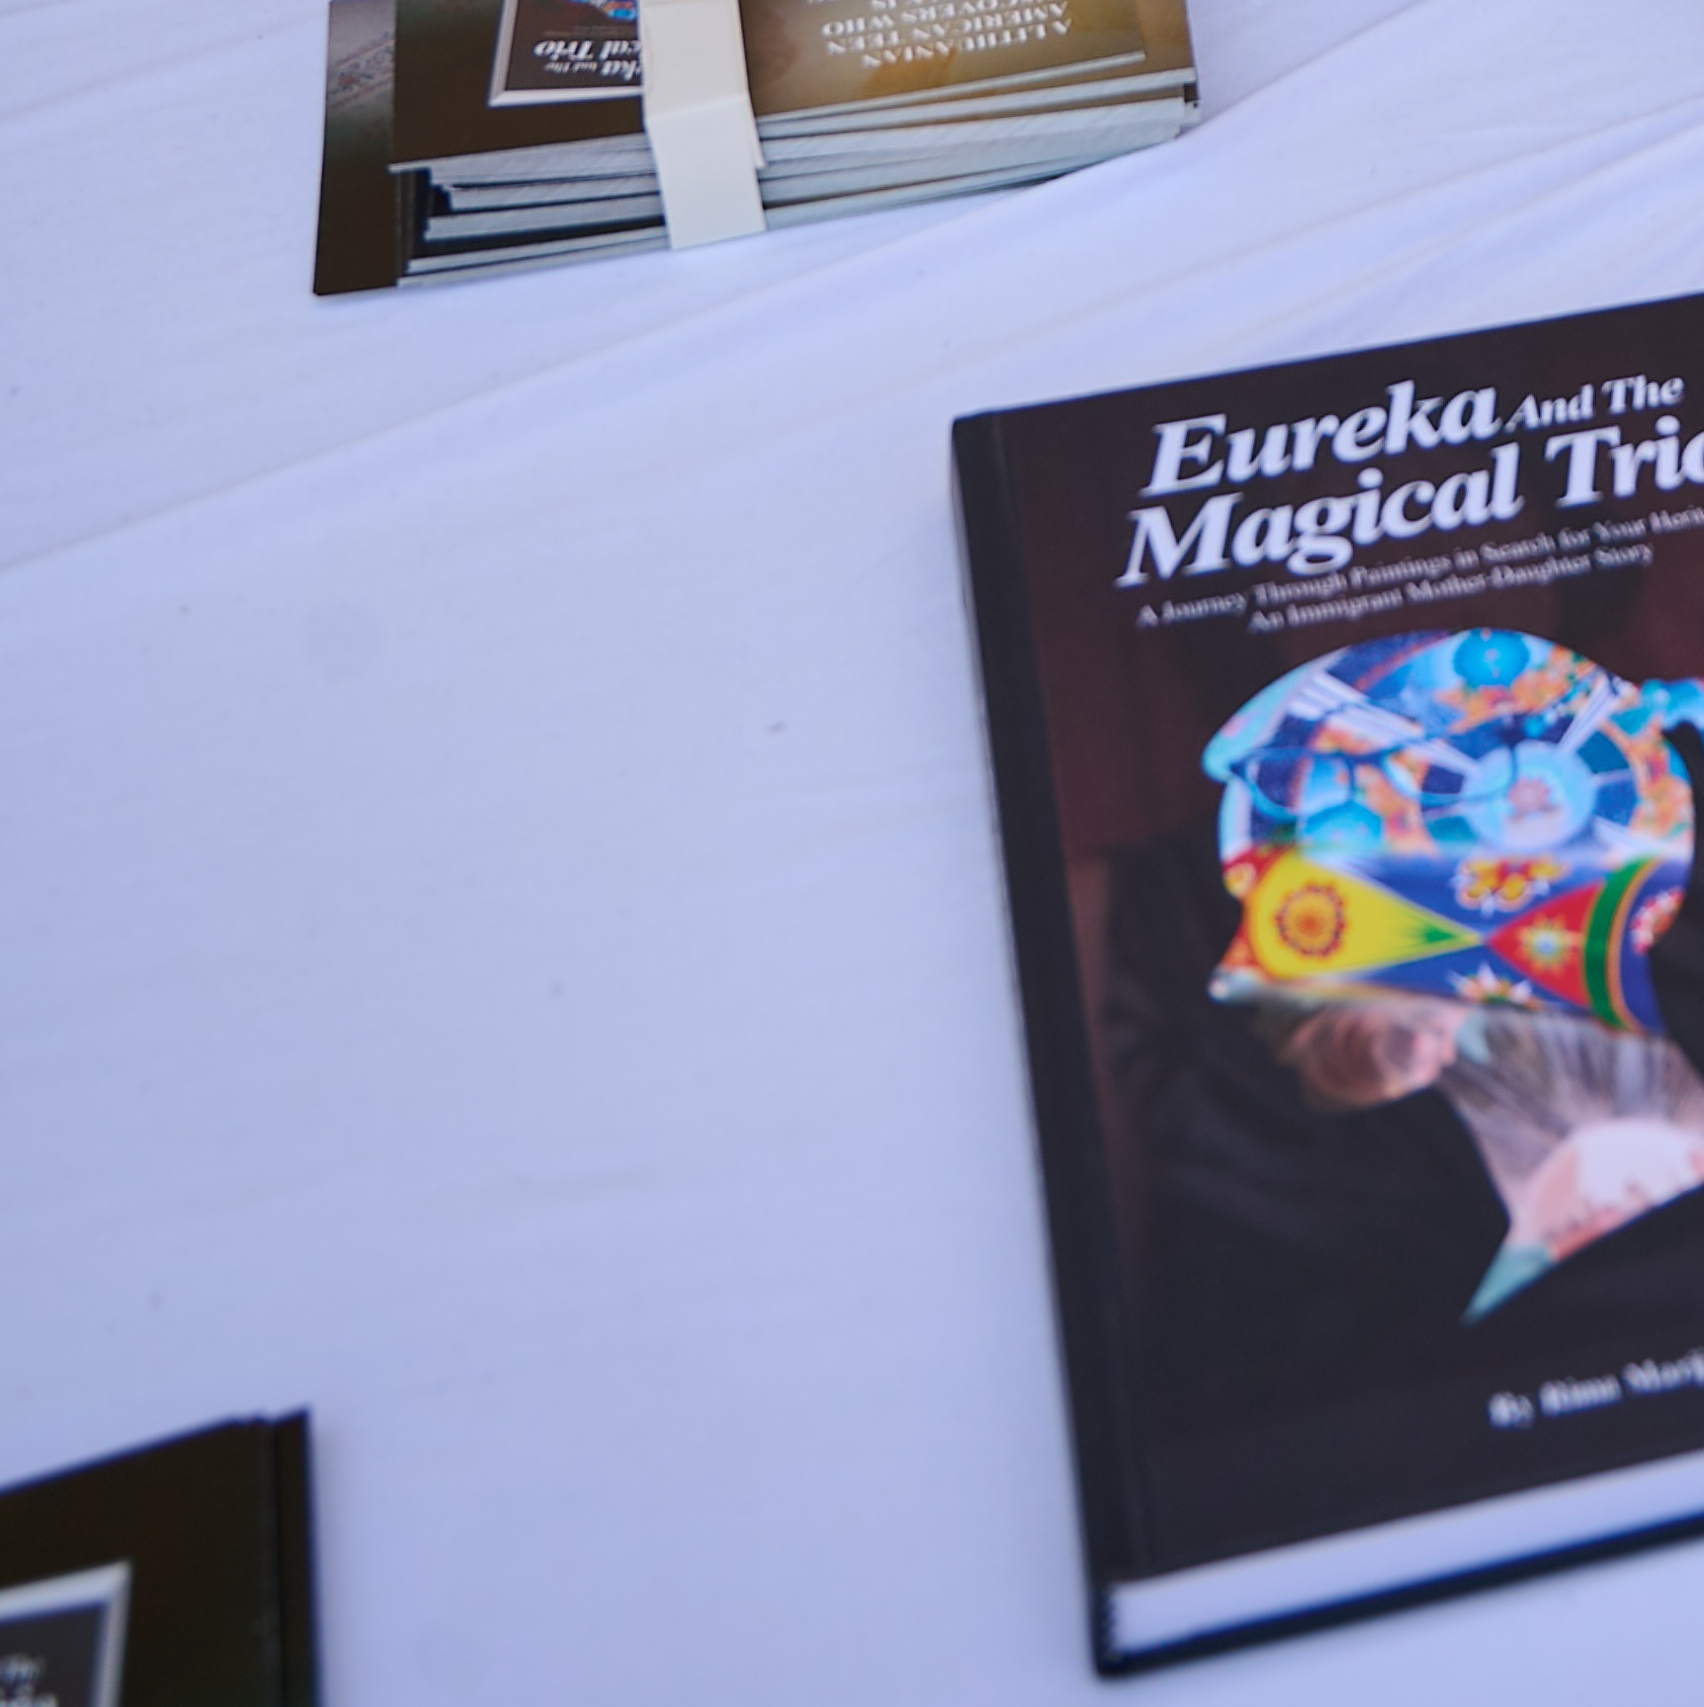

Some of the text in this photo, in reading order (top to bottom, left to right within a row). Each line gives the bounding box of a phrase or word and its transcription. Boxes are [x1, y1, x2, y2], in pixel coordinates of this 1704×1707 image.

[534, 40, 593, 61] Trio
[821, 14, 896, 37] WHO
[826, 1, 1069, 56] AMERICAN TEEN
[1051, 18, 1072, 38] A
[1139, 373, 1686, 497] Eureka And The
[1114, 443, 1524, 587] Magical
[1136, 604, 1159, 629] A
[1161, 592, 1248, 625] Journey
[1252, 571, 1348, 607] Through
[1350, 554, 1452, 588] Paintings
[1453, 547, 1479, 571] in
[1479, 532, 1555, 563] Search
[1558, 527, 1592, 550] for
[1593, 518, 1647, 542] Your
[1249, 542, 1653, 633] An Immigrant Mother-Daughter Story
[1488, 1391, 1535, 1429] By
[1538, 1374, 1622, 1417] Rima
